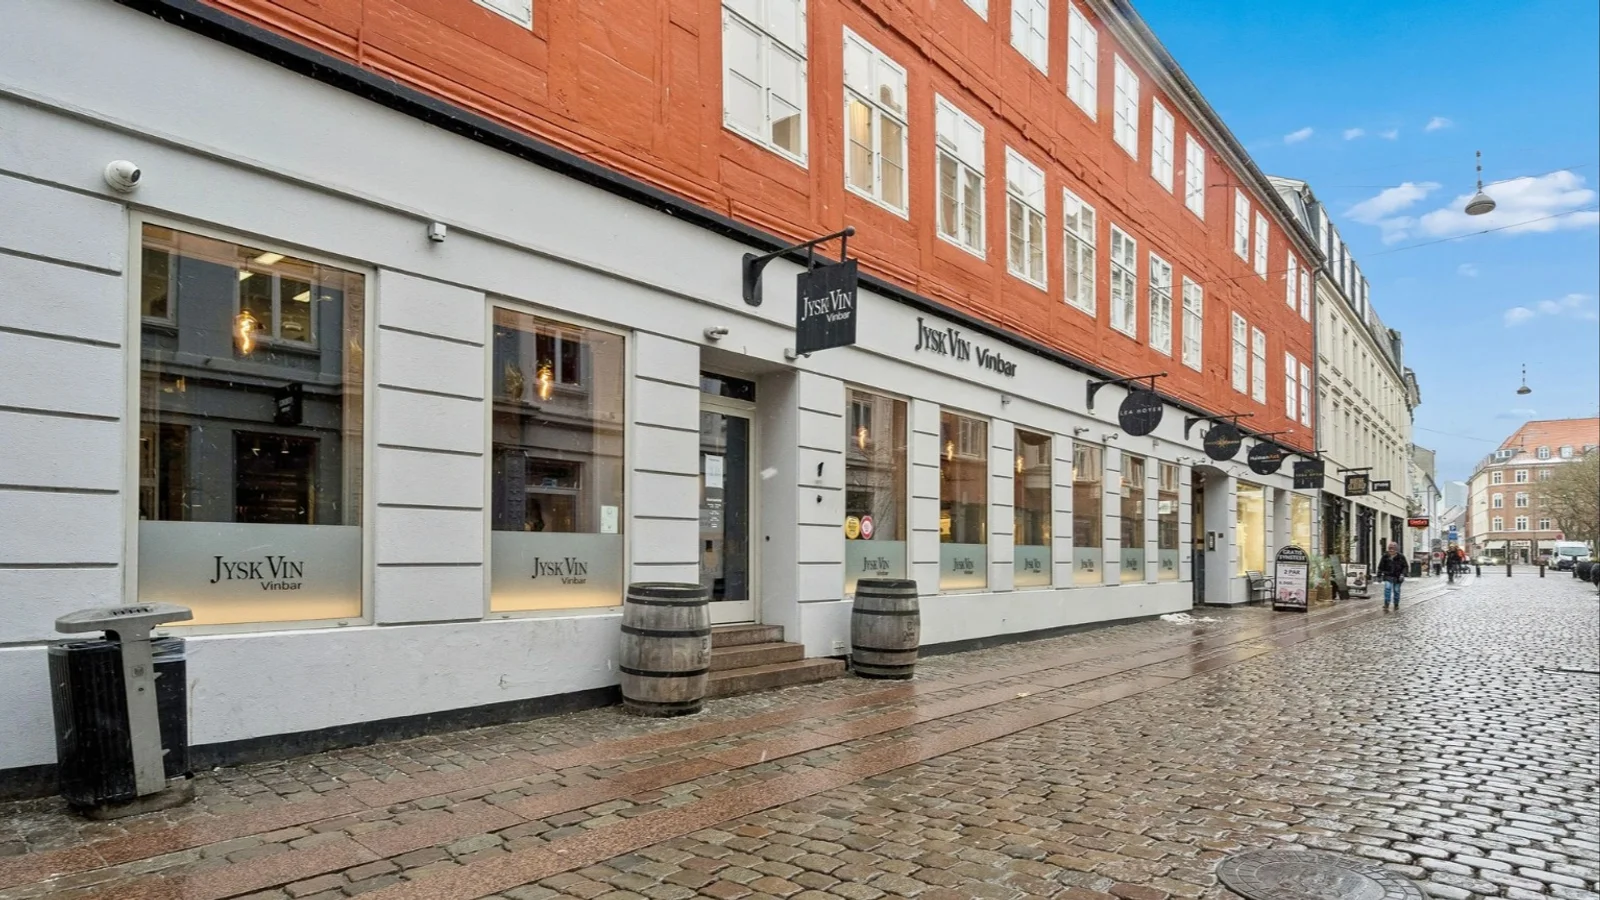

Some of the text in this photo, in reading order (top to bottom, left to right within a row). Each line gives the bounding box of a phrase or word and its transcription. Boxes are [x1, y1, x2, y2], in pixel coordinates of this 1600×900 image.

[801, 288, 853, 321] JYSK VIN
[826, 311, 851, 323] Vinbar
[914, 316, 1018, 378] JYSK VIN Vinbar
[210, 555, 304, 584] JYSK VIN
[531, 556, 588, 579] JYSK VIN
[260, 580, 303, 591] Vinbar
[561, 577, 587, 585] Vinbar
